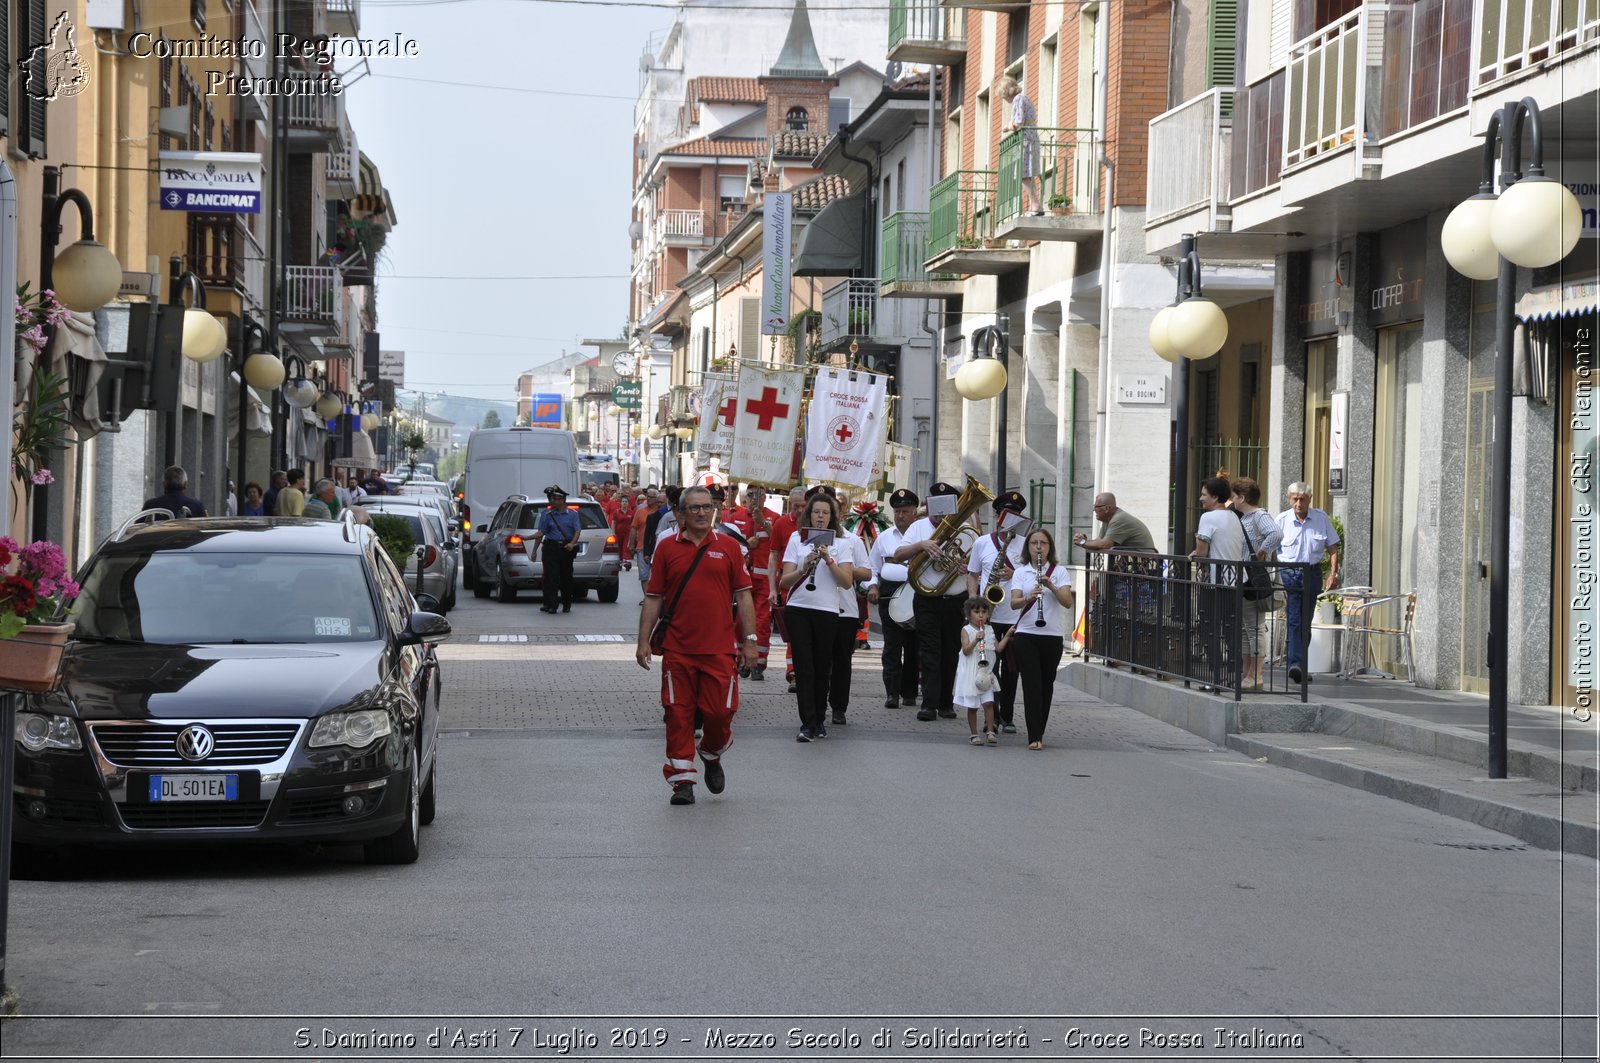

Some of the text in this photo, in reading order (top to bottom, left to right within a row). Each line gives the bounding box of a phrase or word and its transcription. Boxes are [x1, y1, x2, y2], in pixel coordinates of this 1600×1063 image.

[164, 168, 255, 183] BANCA D'ALBA
[186, 193, 256, 207] BANCOMAT
[770, 194, 785, 316] NuovaCasaImmobiliare
[616, 386, 640, 395] Punto
[830, 392, 868, 403] CROCE ROSSA
[535, 403, 559, 417] IP
[836, 401, 860, 409] ITALIANA
[815, 455, 841, 464] COMITATO
[842, 458, 864, 468] LOCALE
[162, 780, 225, 797] DL 501EA
